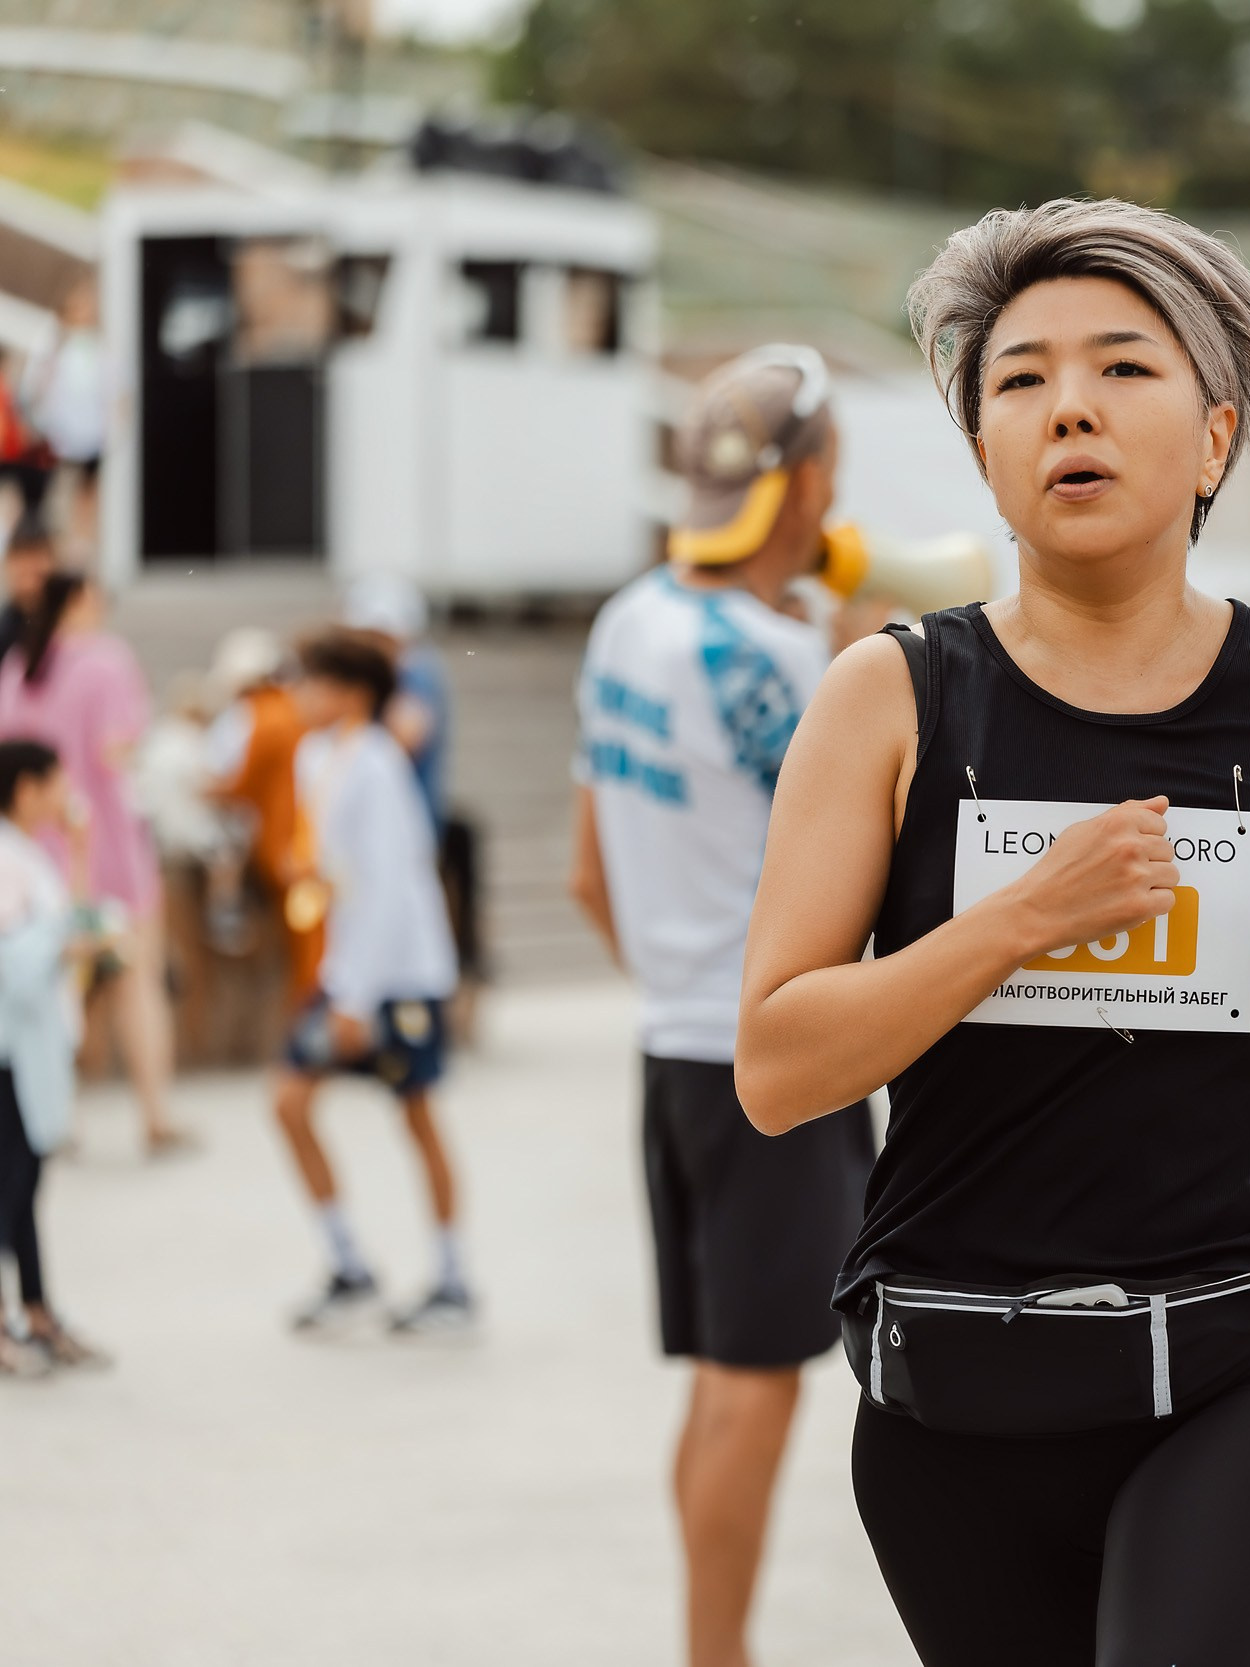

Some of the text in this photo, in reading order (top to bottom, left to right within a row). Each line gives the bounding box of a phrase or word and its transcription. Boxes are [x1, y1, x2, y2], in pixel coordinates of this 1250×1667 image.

[1168, 837, 1236, 863] ORO
[991, 984, 1228, 1006] ЛАГОТВОРИТЕЛЬНЫЙ ЗАБЕГ
